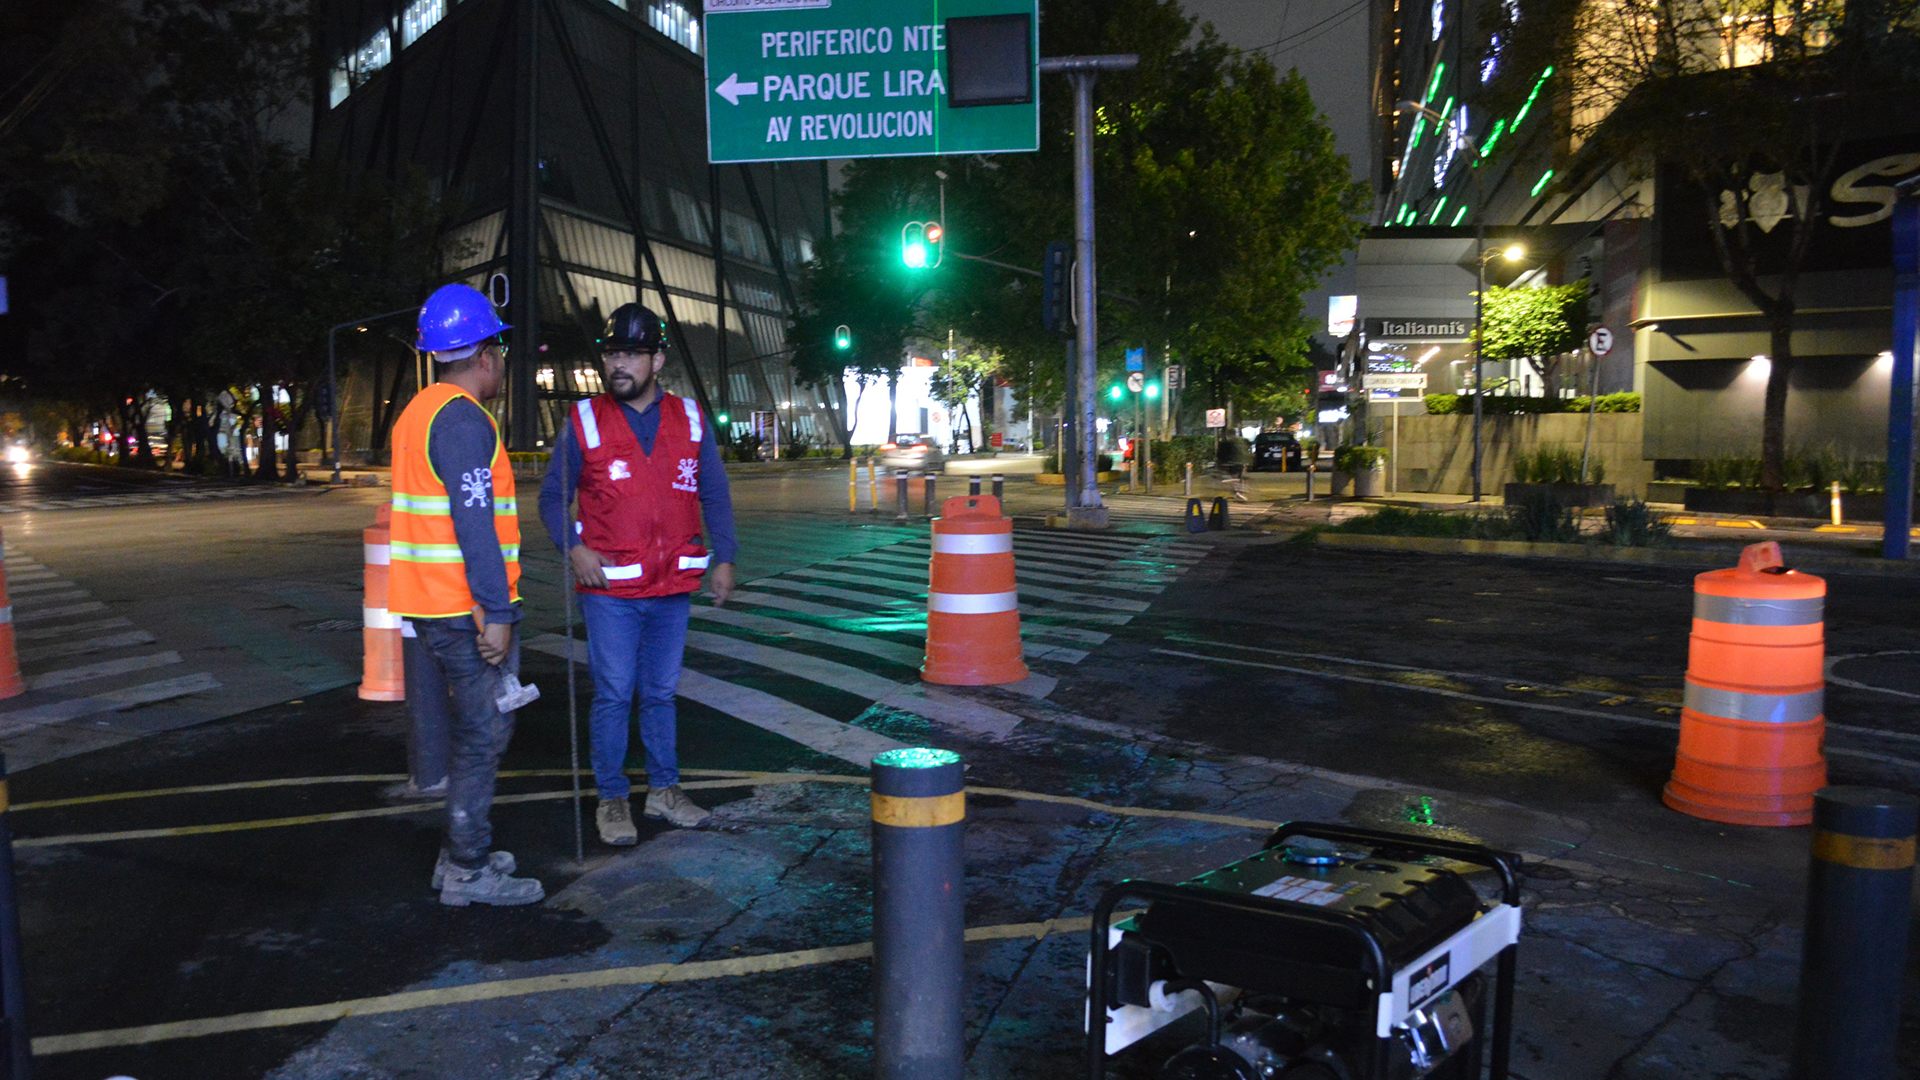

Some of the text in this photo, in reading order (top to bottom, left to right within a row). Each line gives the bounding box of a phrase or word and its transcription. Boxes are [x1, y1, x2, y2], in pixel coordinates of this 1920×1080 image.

[761, 24, 946, 58] PERIFERICO NTE
[763, 69, 947, 102] PARQUE LIRA
[766, 110, 933, 143] AV REVOLUCION
[1381, 321, 1465, 336] Italianni's
